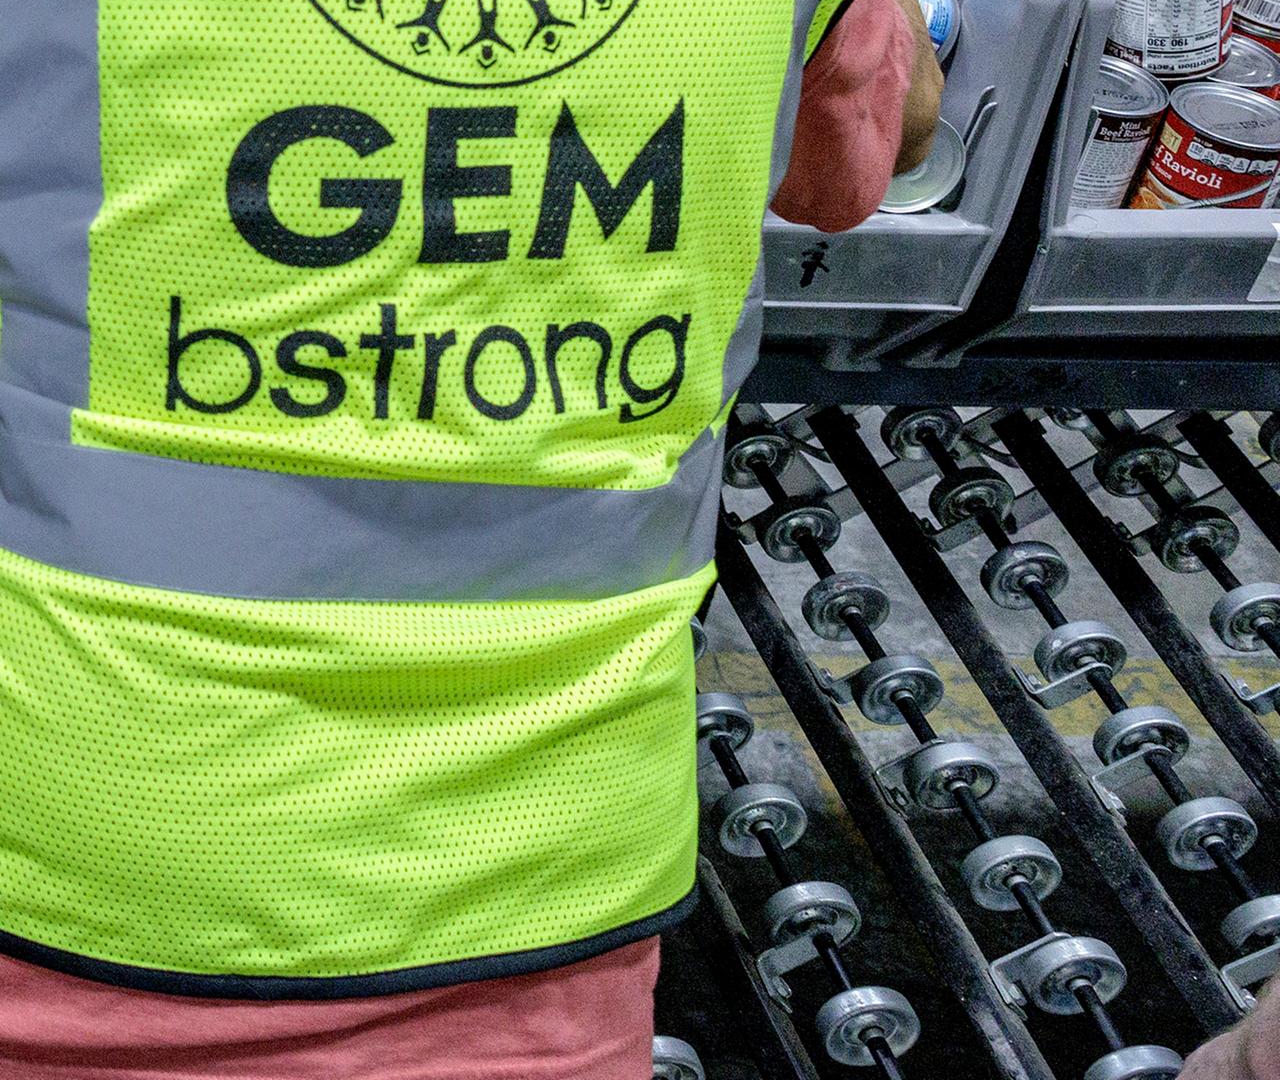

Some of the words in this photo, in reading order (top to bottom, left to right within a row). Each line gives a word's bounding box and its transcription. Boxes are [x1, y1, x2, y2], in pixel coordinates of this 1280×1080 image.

[1148, 38, 1166, 47] 330
[1171, 38, 1188, 47] 190
[1099, 127, 1122, 137] Beef
[1120, 121, 1140, 131] Mini
[1162, 147, 1223, 189] Ravioli
[226, 96, 686, 270] GEM
[165, 296, 692, 425] bstrong
